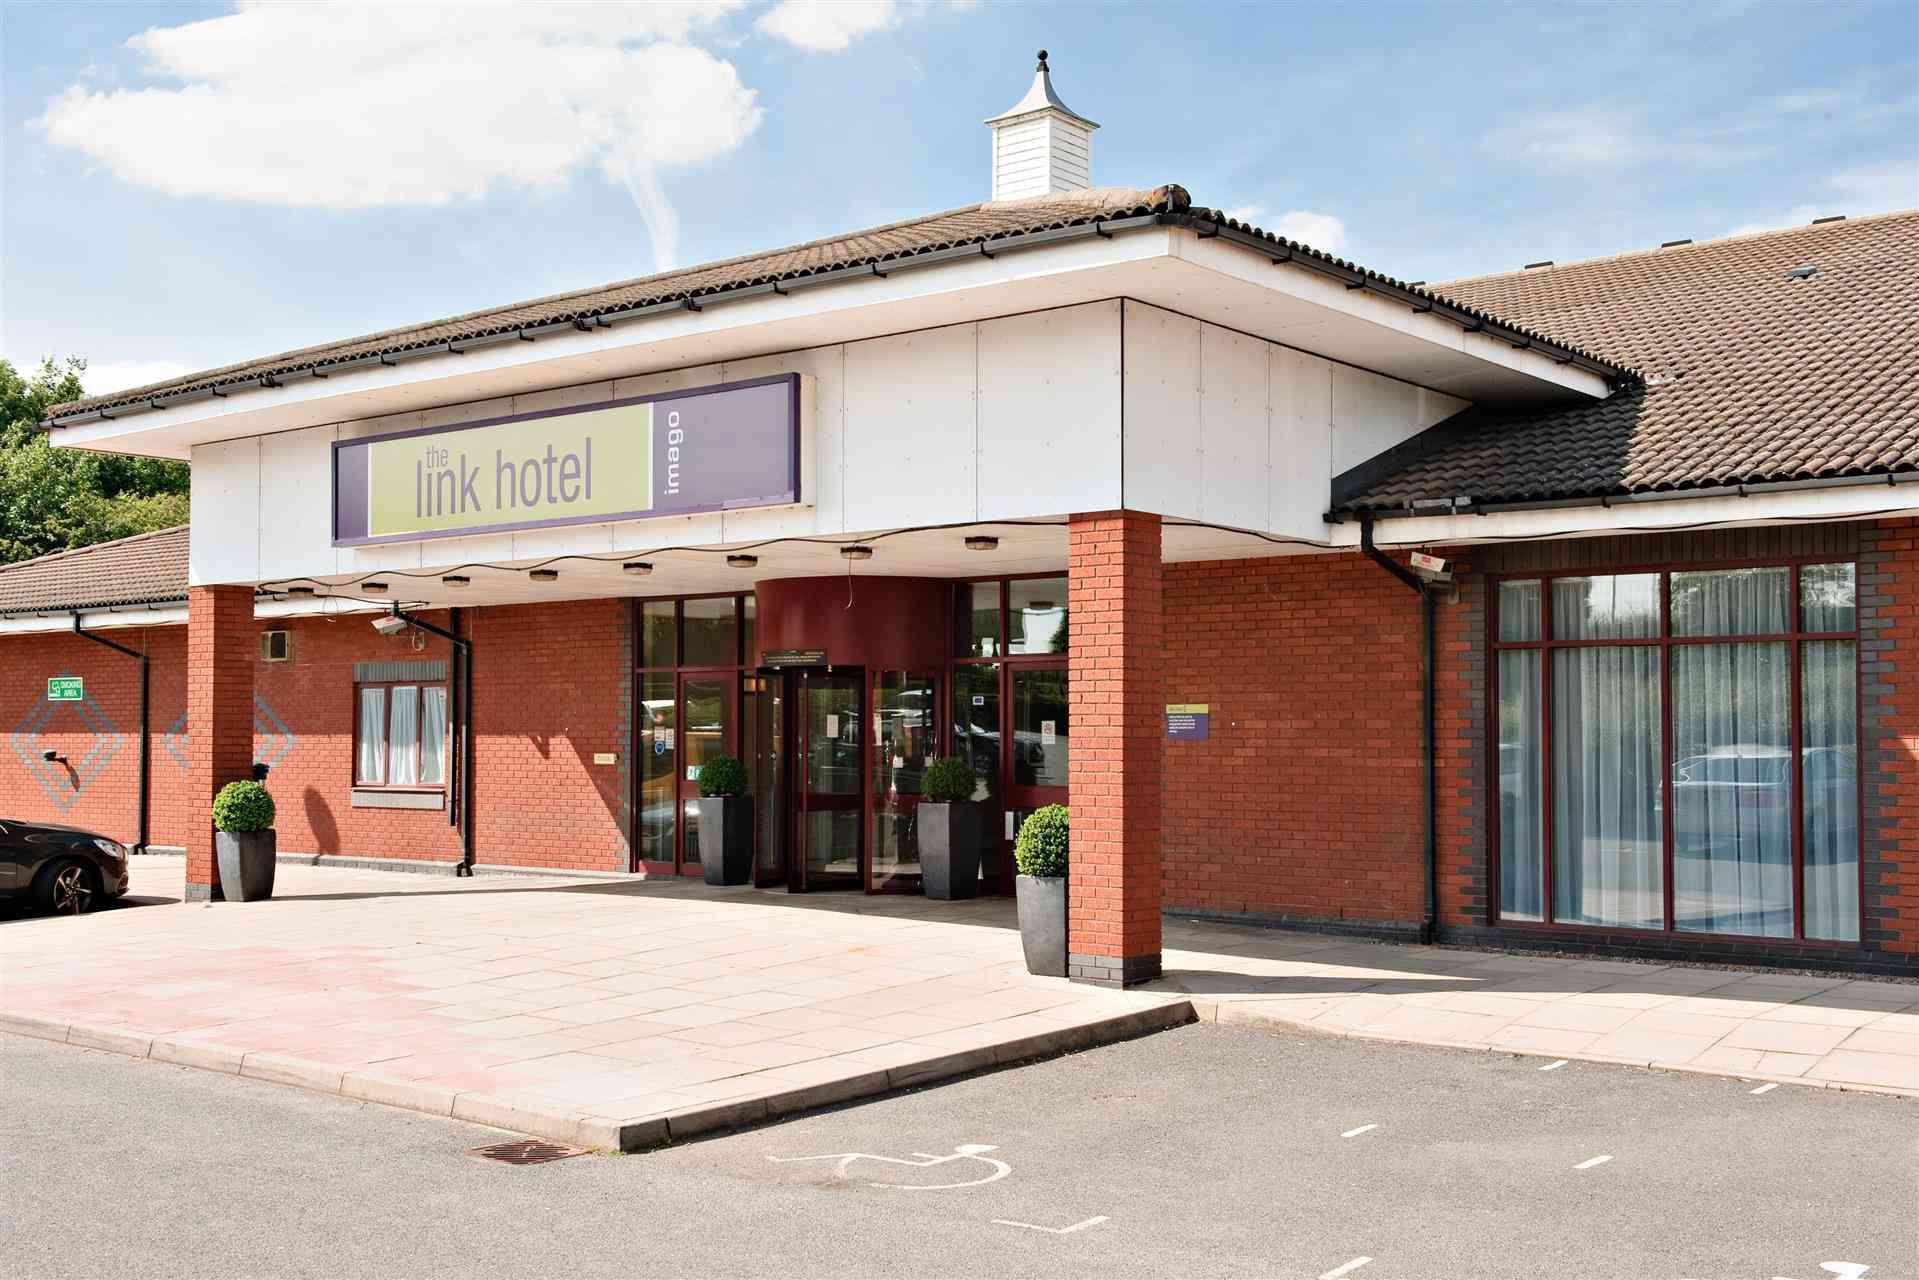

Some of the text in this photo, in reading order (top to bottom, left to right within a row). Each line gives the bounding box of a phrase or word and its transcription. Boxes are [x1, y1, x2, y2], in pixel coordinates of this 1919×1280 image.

[416, 436, 592, 518] link hotel
[426, 445, 448, 468] the
[664, 411, 683, 495] imago
